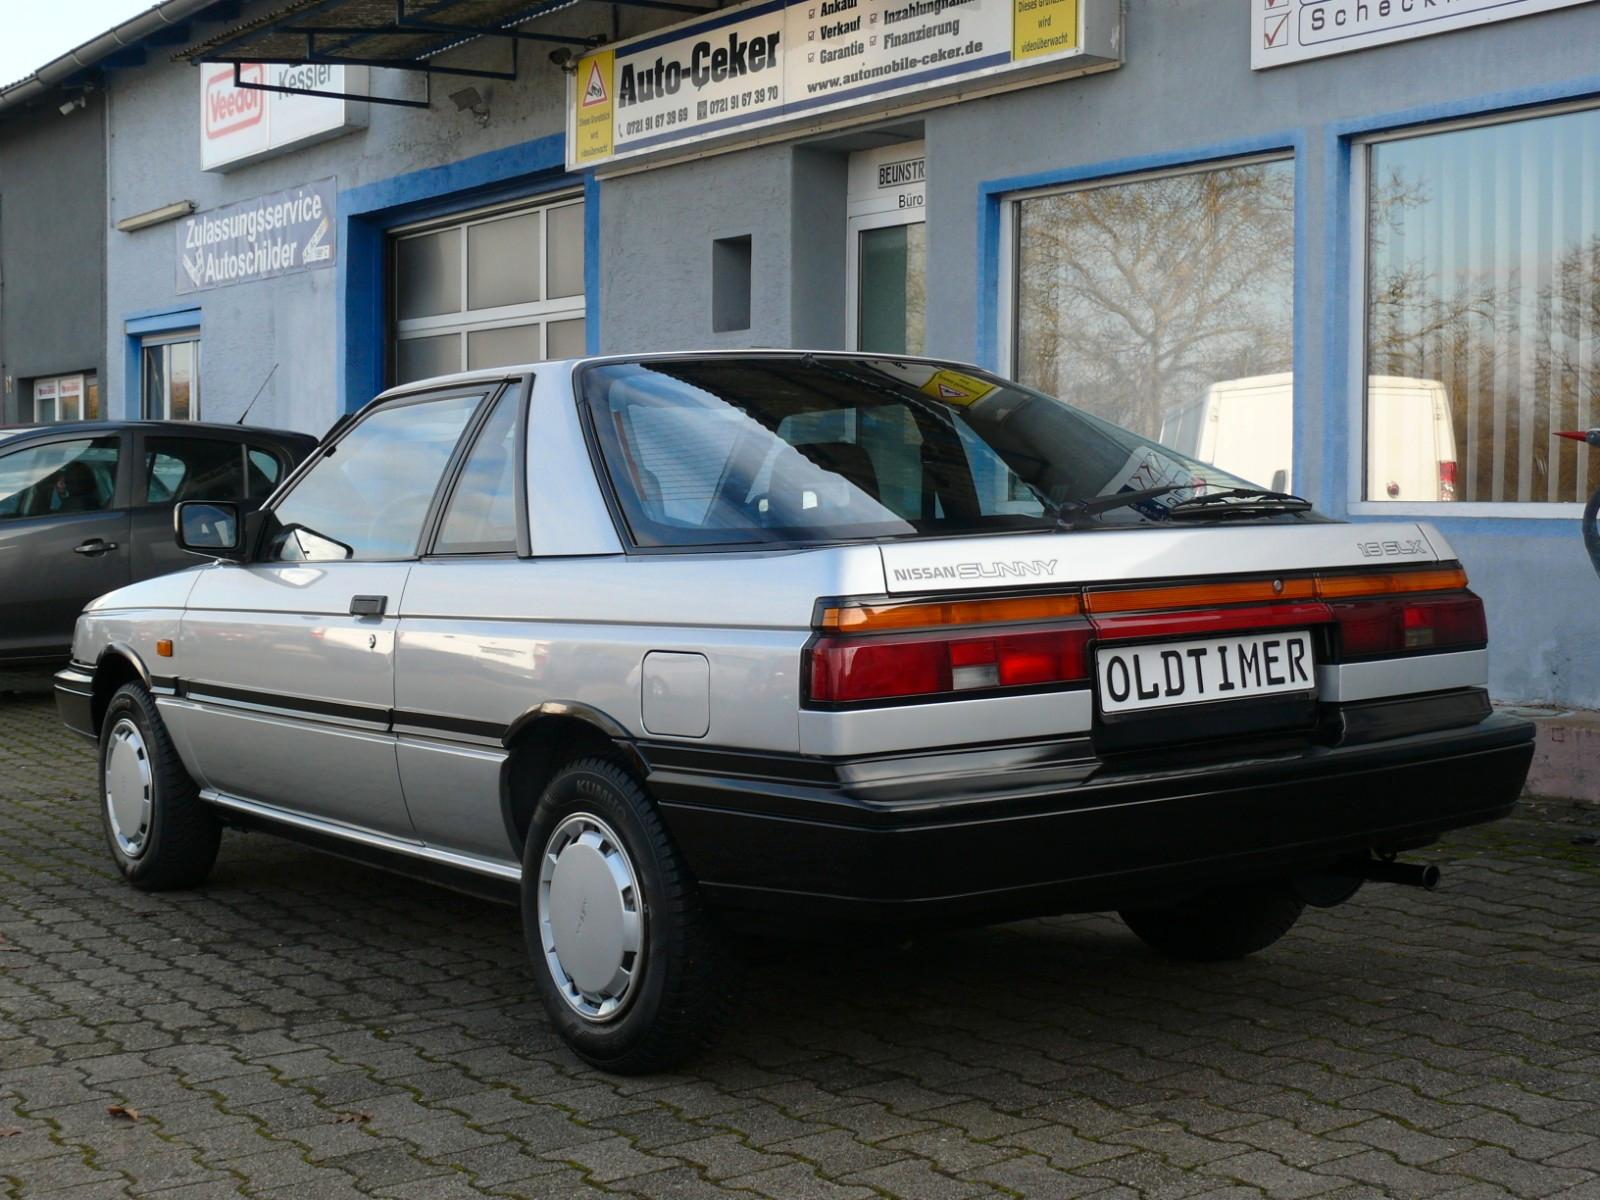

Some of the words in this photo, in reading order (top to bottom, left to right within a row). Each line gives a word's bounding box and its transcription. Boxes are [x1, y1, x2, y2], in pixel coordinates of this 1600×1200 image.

[820, 16, 861, 41] Verkauf
[883, 19, 960, 50] Finanzierung
[1038, 14, 1052, 28] wird
[820, 40, 865, 65] Garantie
[807, 41, 983, 93] www.automobile-ceker.de
[210, 76, 258, 123] Veedol
[709, 98, 728, 115] 0721
[731, 95, 739, 111] 91
[741, 91, 752, 107] 67
[754, 89, 765, 104] 39
[767, 85, 778, 100] 70
[626, 118, 643, 136] 0721
[645, 116, 654, 132] 91
[655, 113, 665, 128] 67
[666, 110, 677, 126] 39
[898, 193, 924, 209] Büro
[185, 191, 322, 249] Zulassungsservice
[204, 237, 297, 283] Autoschilder
[1382, 539, 1427, 556] SLX
[894, 565, 956, 581] NISSAN
[956, 559, 1059, 580] SUNNY
[1106, 635, 1310, 704] OLDTIMER
